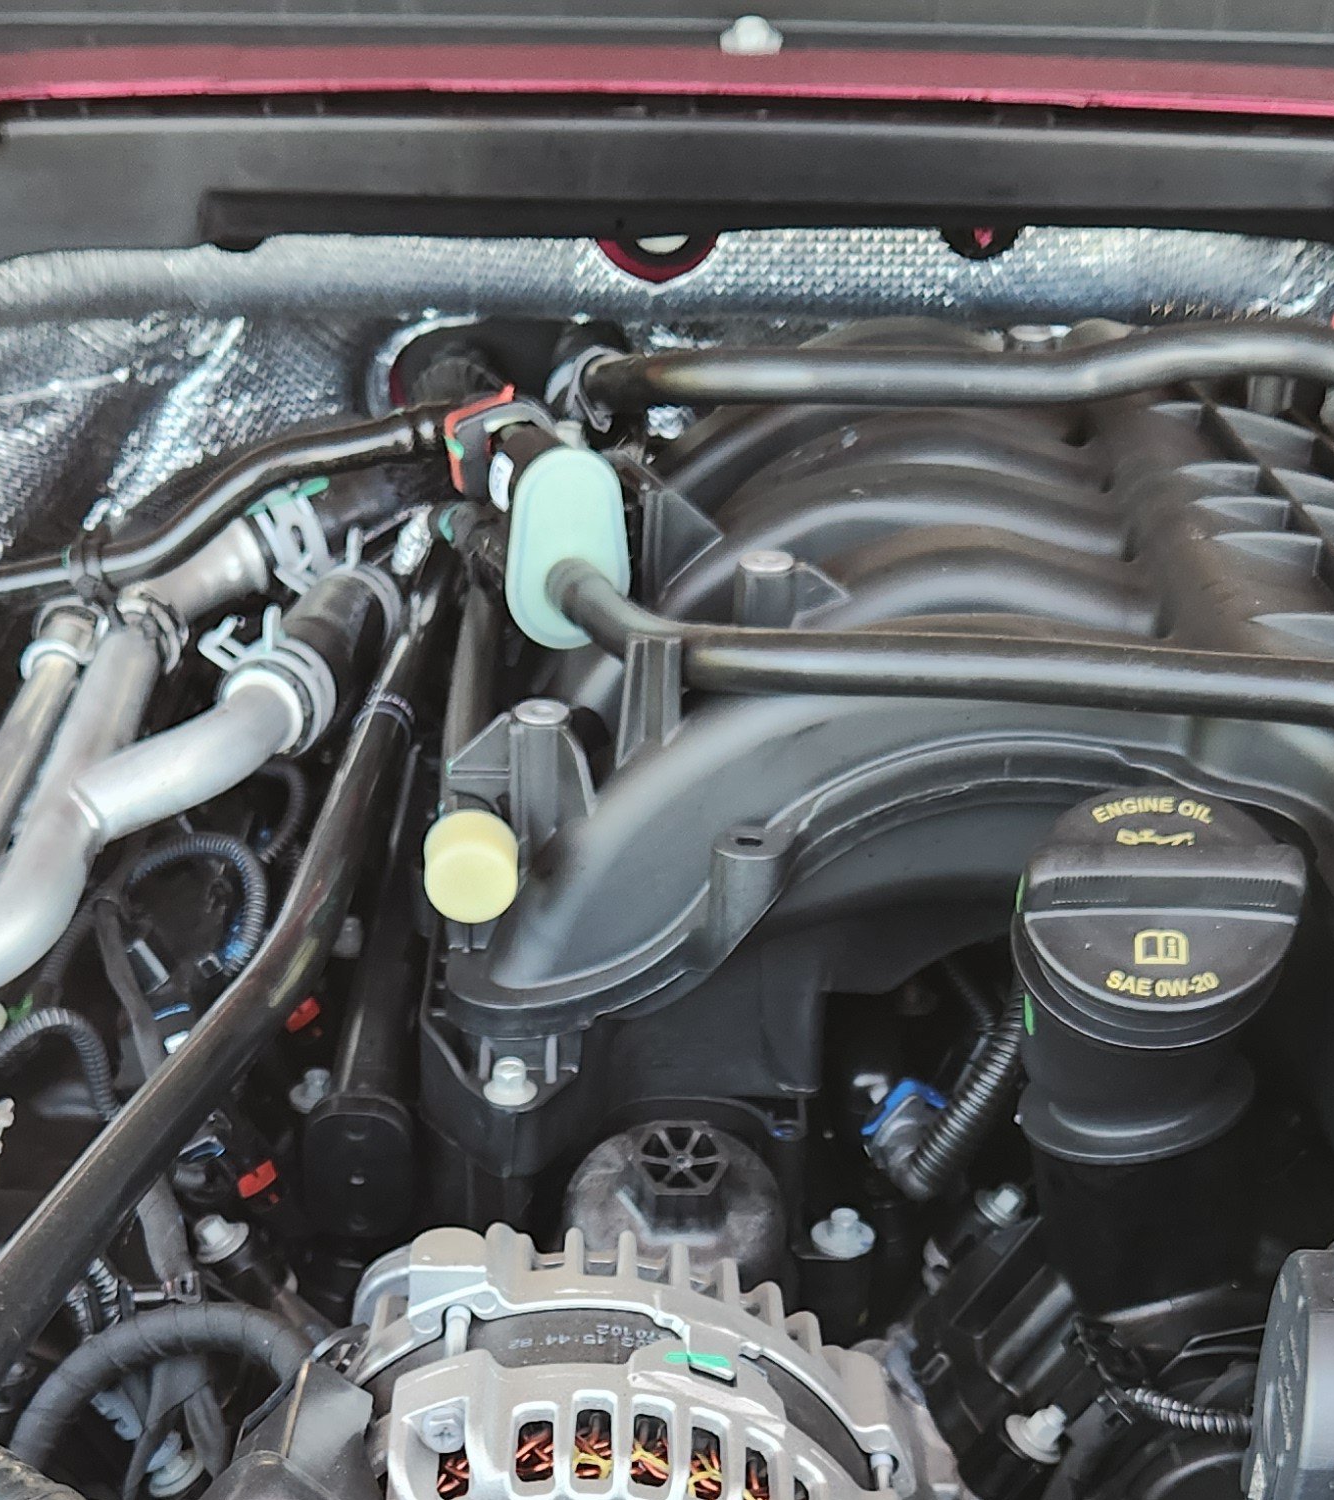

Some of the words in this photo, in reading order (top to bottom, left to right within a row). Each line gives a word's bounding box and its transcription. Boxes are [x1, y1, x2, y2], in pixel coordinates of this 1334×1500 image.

[1091, 796, 1175, 825] ENGINE
[1177, 798, 1215, 825] OIL
[1105, 970, 1152, 997] SAE
[1155, 970, 1220, 998] 0W-20
